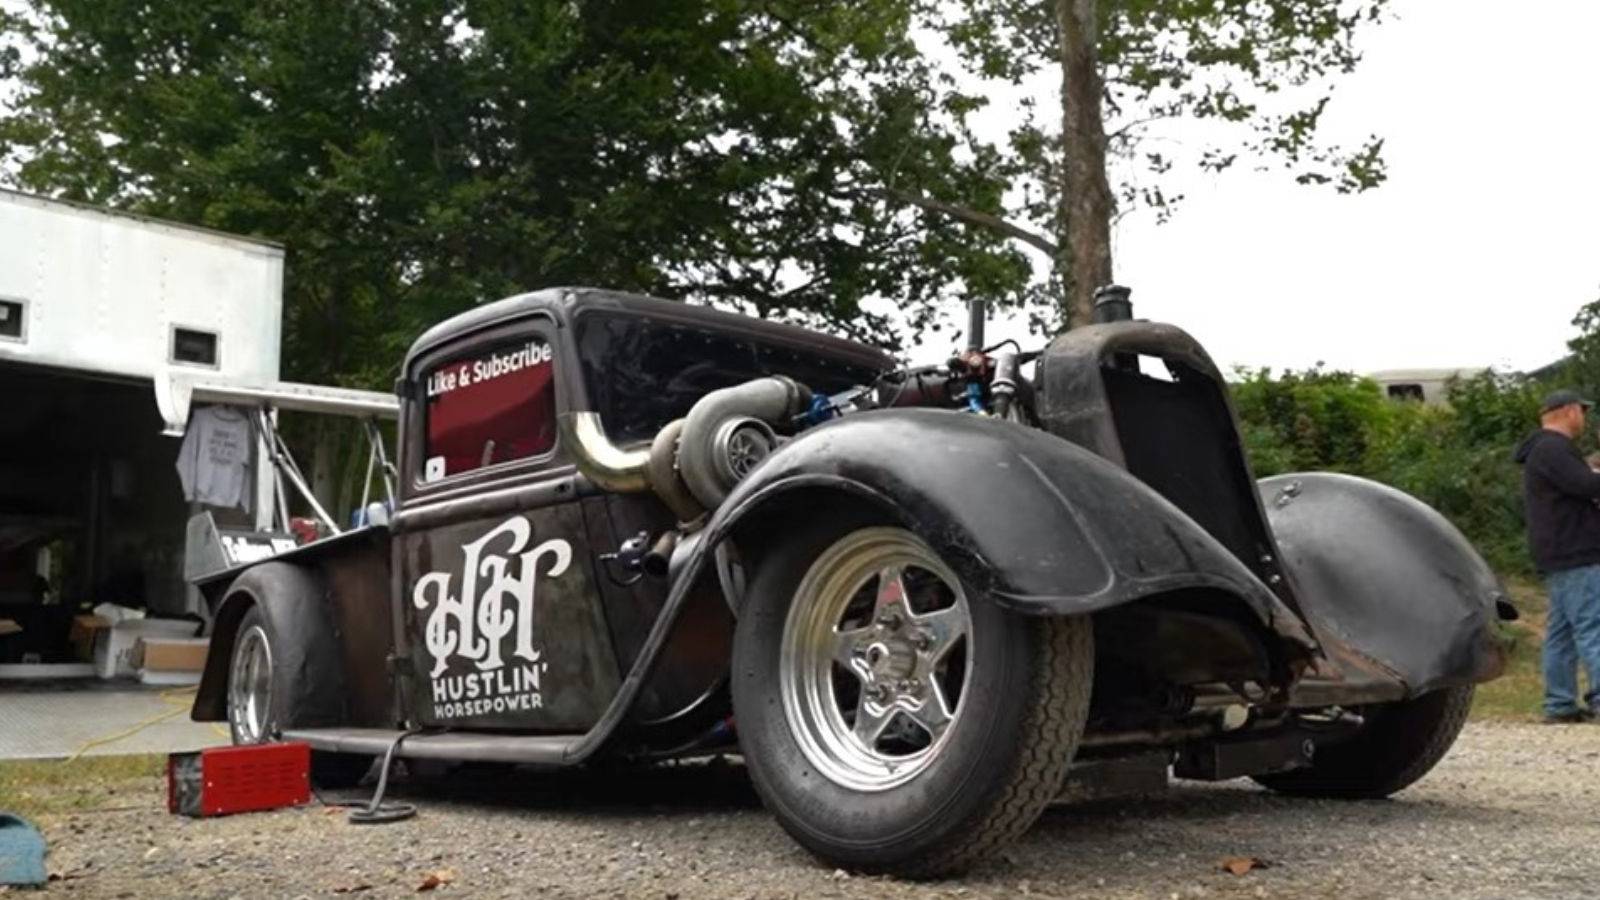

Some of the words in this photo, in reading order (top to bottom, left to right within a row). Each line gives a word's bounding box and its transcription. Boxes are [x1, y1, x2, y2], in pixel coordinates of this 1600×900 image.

[427, 368, 456, 396] Like
[459, 366, 470, 387] &
[473, 342, 552, 383] Subscribe
[432, 663, 548, 702] HUSTLIN'
[435, 694, 542, 719] HORSEPOWER
